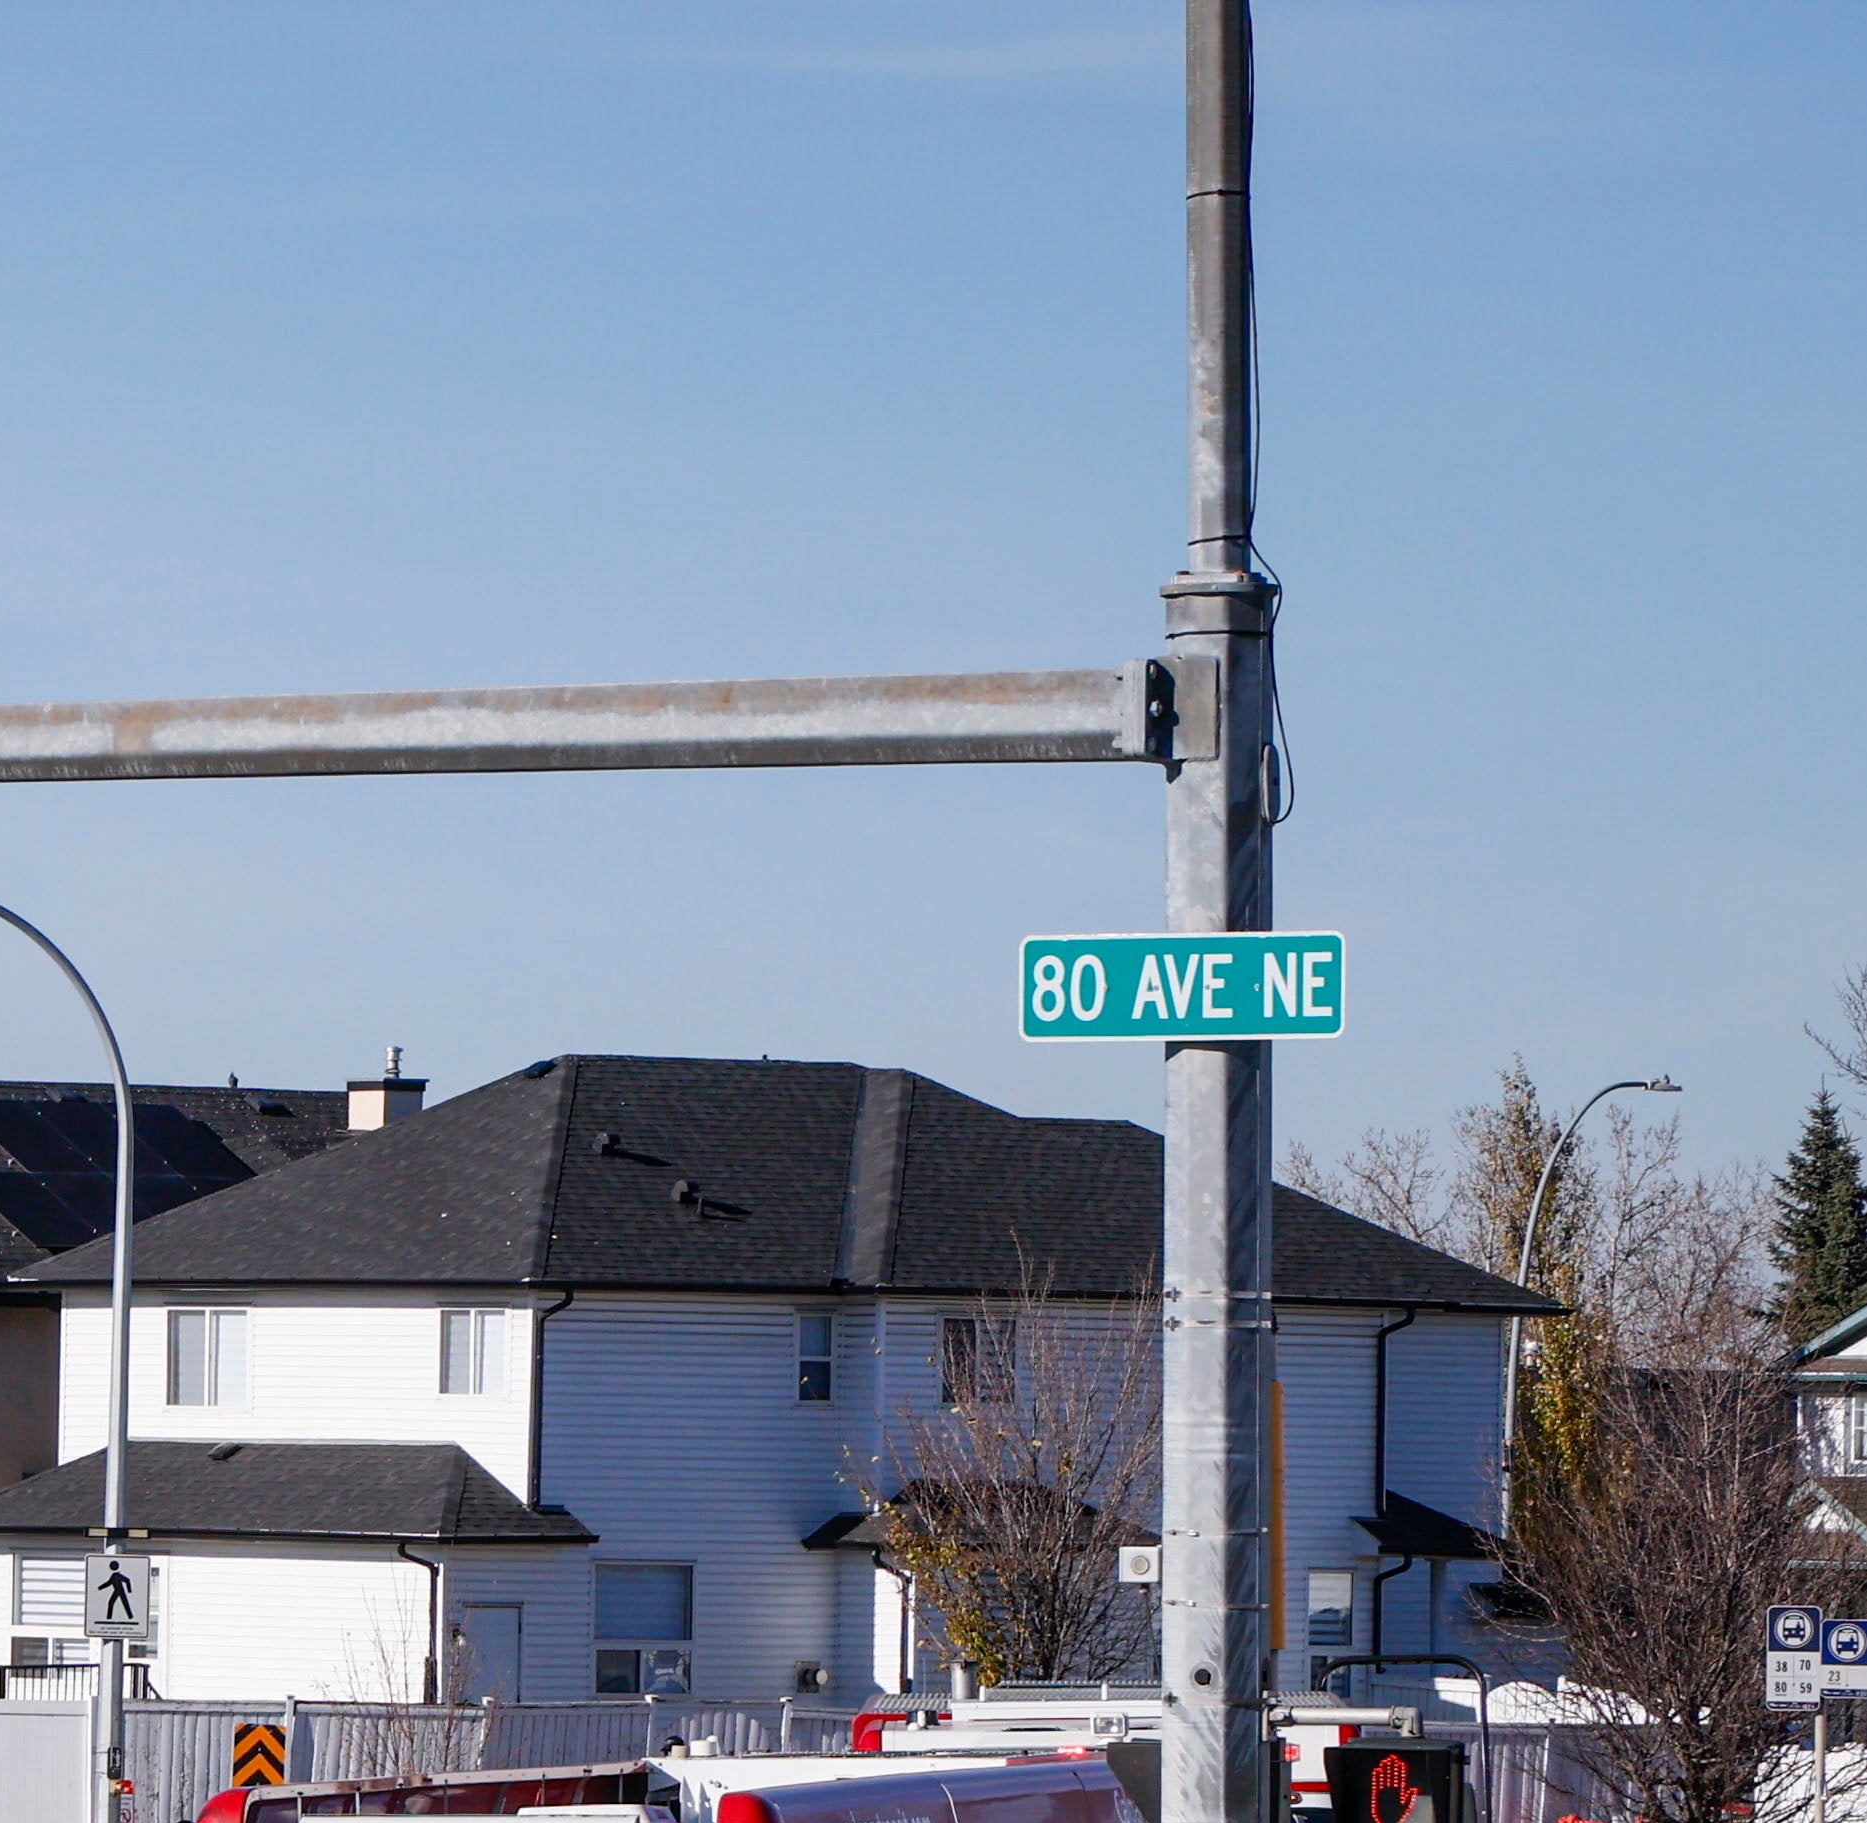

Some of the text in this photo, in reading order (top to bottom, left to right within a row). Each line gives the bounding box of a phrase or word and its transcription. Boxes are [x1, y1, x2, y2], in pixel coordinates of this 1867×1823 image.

[1032, 951, 1333, 1021] 80 AVE NE
[1775, 1659, 1811, 1673] 38 70
[1828, 1670, 1841, 1682] 23
[1774, 1681, 1787, 1693] 80
[1799, 1682, 1812, 1694] 59
